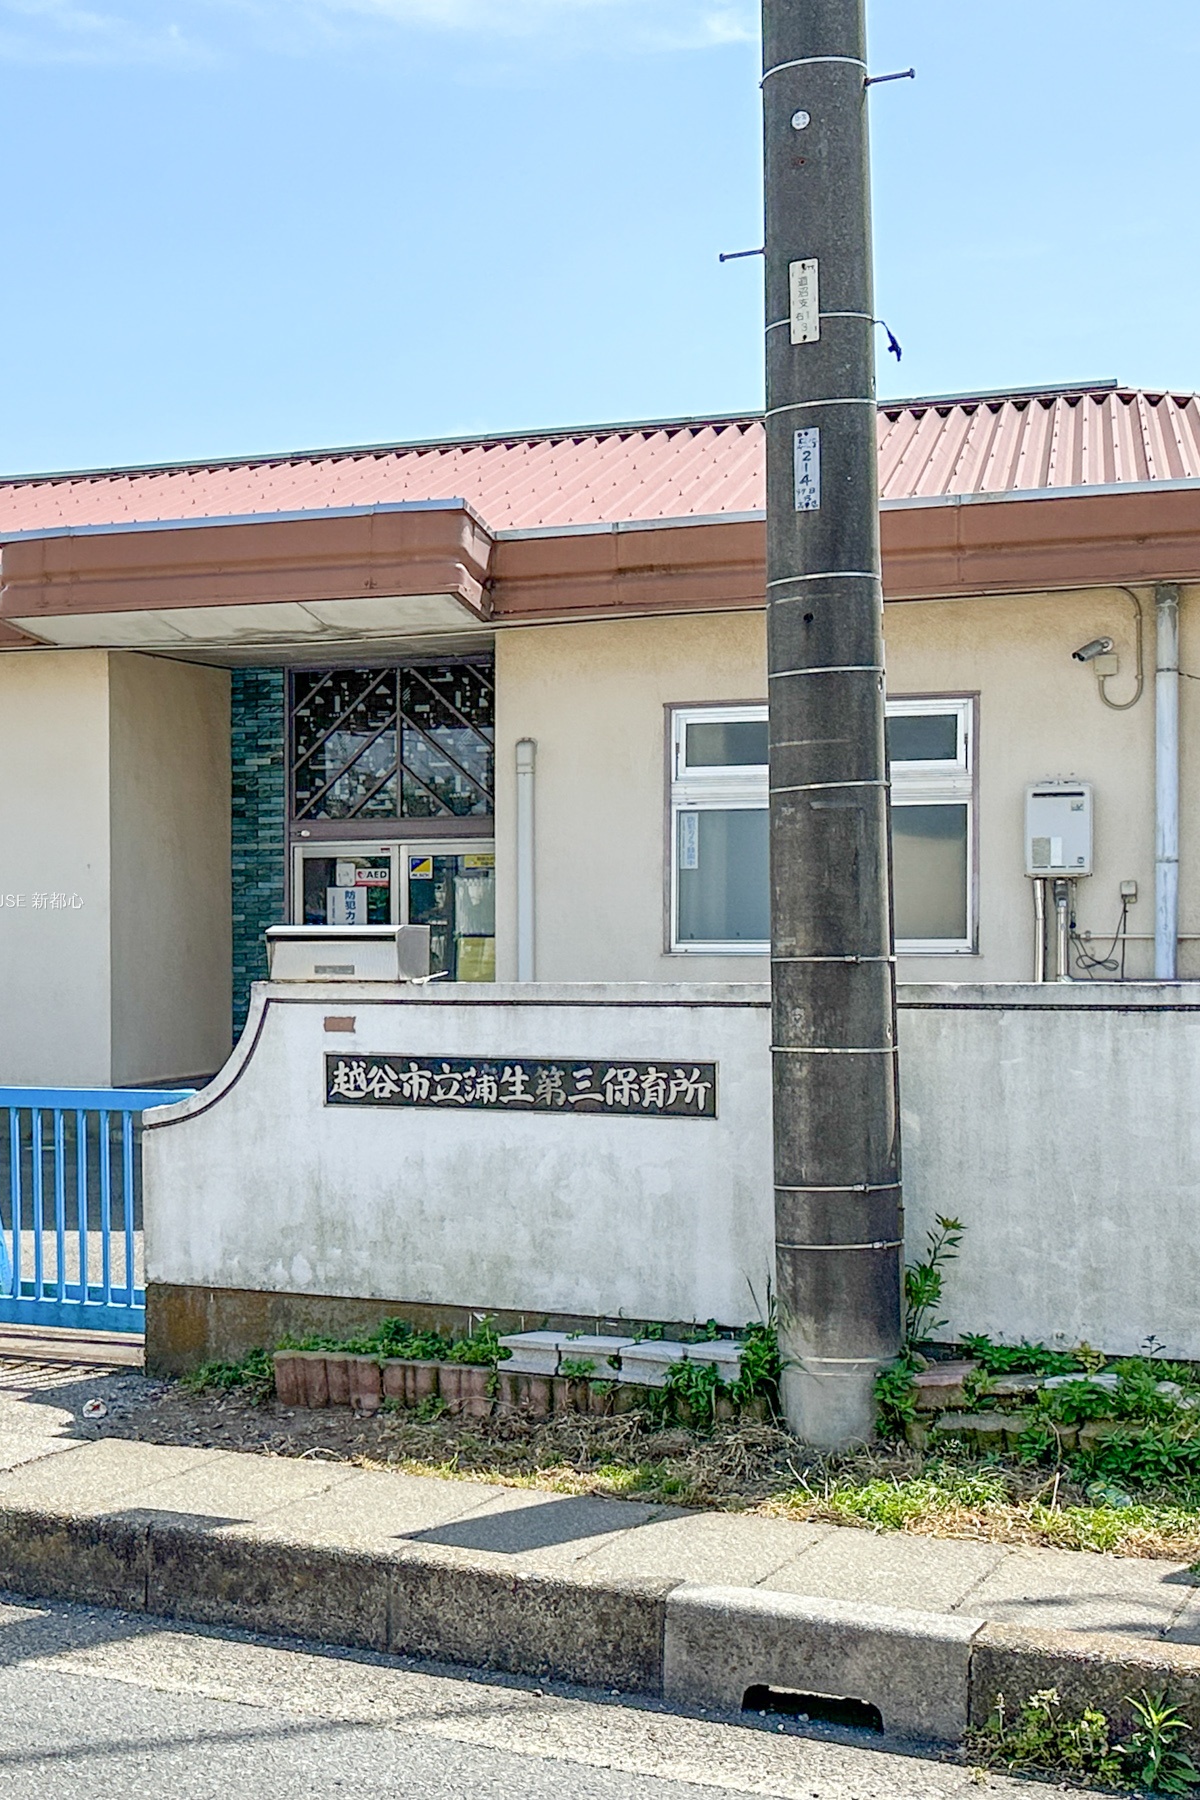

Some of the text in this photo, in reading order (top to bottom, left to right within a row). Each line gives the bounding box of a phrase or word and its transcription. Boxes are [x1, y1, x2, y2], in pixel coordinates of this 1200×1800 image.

[366, 870, 387, 879] AED
[329, 1060, 713, 1110] 越谷市立蒲生第三保育所
